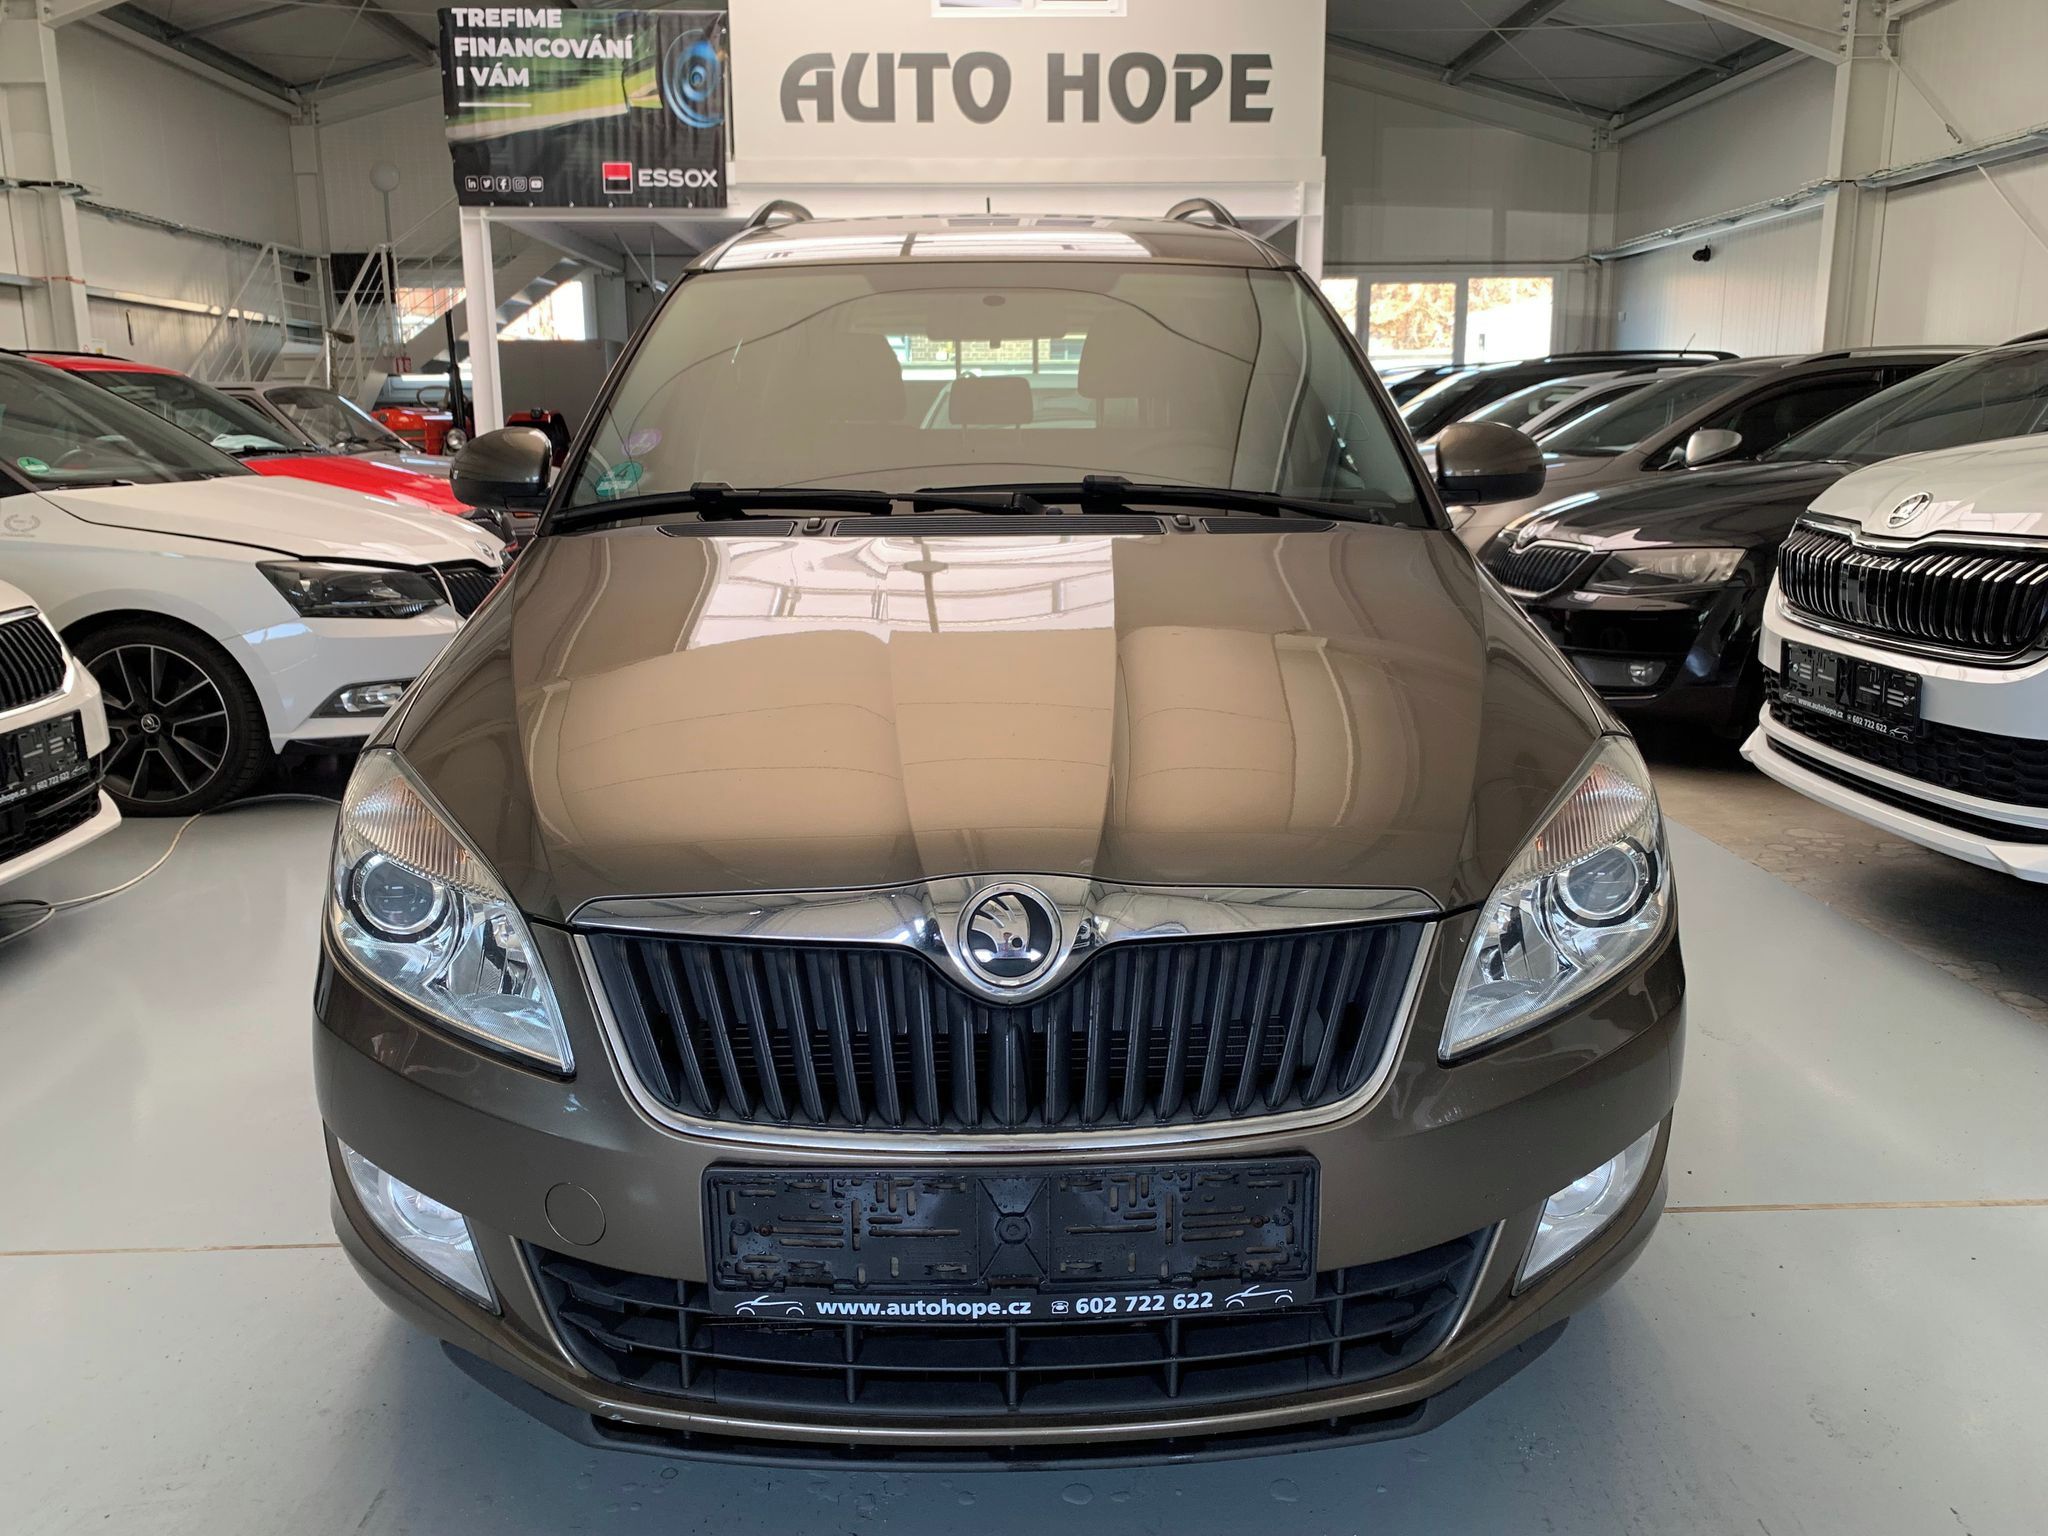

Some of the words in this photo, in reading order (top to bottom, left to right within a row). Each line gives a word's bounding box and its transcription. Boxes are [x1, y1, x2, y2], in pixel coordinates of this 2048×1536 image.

[451, 8, 563, 28] TREFIME
[454, 34, 633, 60] FINANCOVÁNÍ
[456, 67, 463, 87] I
[470, 62, 530, 87] VÁM
[779, 51, 1012, 124] AUTO
[1046, 51, 1275, 124] HOPE
[638, 169, 718, 188] ESSOX
[1798, 698, 1844, 719] www.autohope.cz
[1852, 715, 1863, 726] 602
[1864, 718, 1875, 730] 722
[1875, 722, 1888, 734] 622
[815, 1298, 1032, 1320] www.autohope.cz
[1075, 1297, 1117, 1314] 602
[1124, 1295, 1165, 1312] 722
[1173, 1292, 1213, 1309] 622
